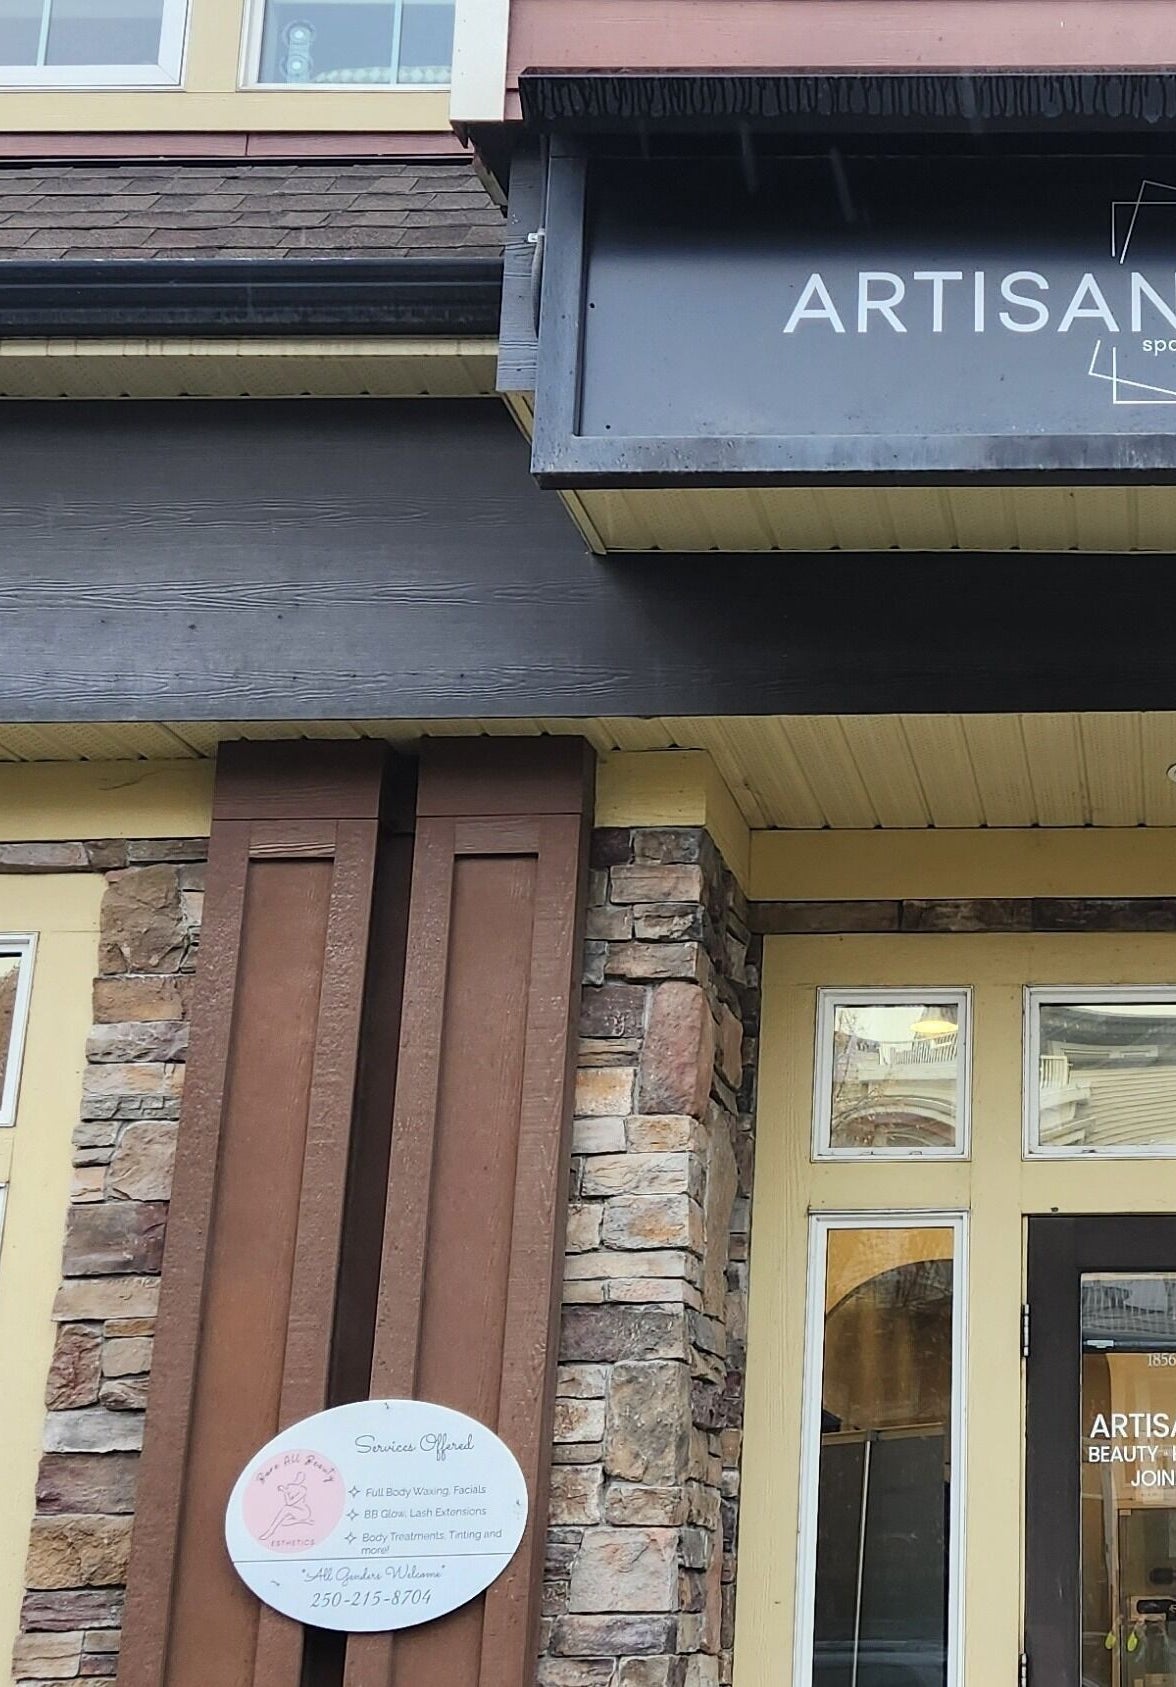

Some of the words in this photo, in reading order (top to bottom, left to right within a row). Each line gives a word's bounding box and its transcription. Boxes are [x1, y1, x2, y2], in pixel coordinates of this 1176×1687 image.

[1147, 1352, 1176, 1367] 1856
[354, 1434, 416, 1454] Services
[420, 1433, 475, 1461] Offered
[1088, 1445, 1159, 1463] BEAUTY
[365, 1487, 384, 1497] Full
[454, 1484, 487, 1495] Facials
[409, 1508, 433, 1518] Lash
[435, 1507, 487, 1517] Extensions
[483, 1529, 503, 1539] and
[310, 1589, 432, 1607] 250-215-8704
